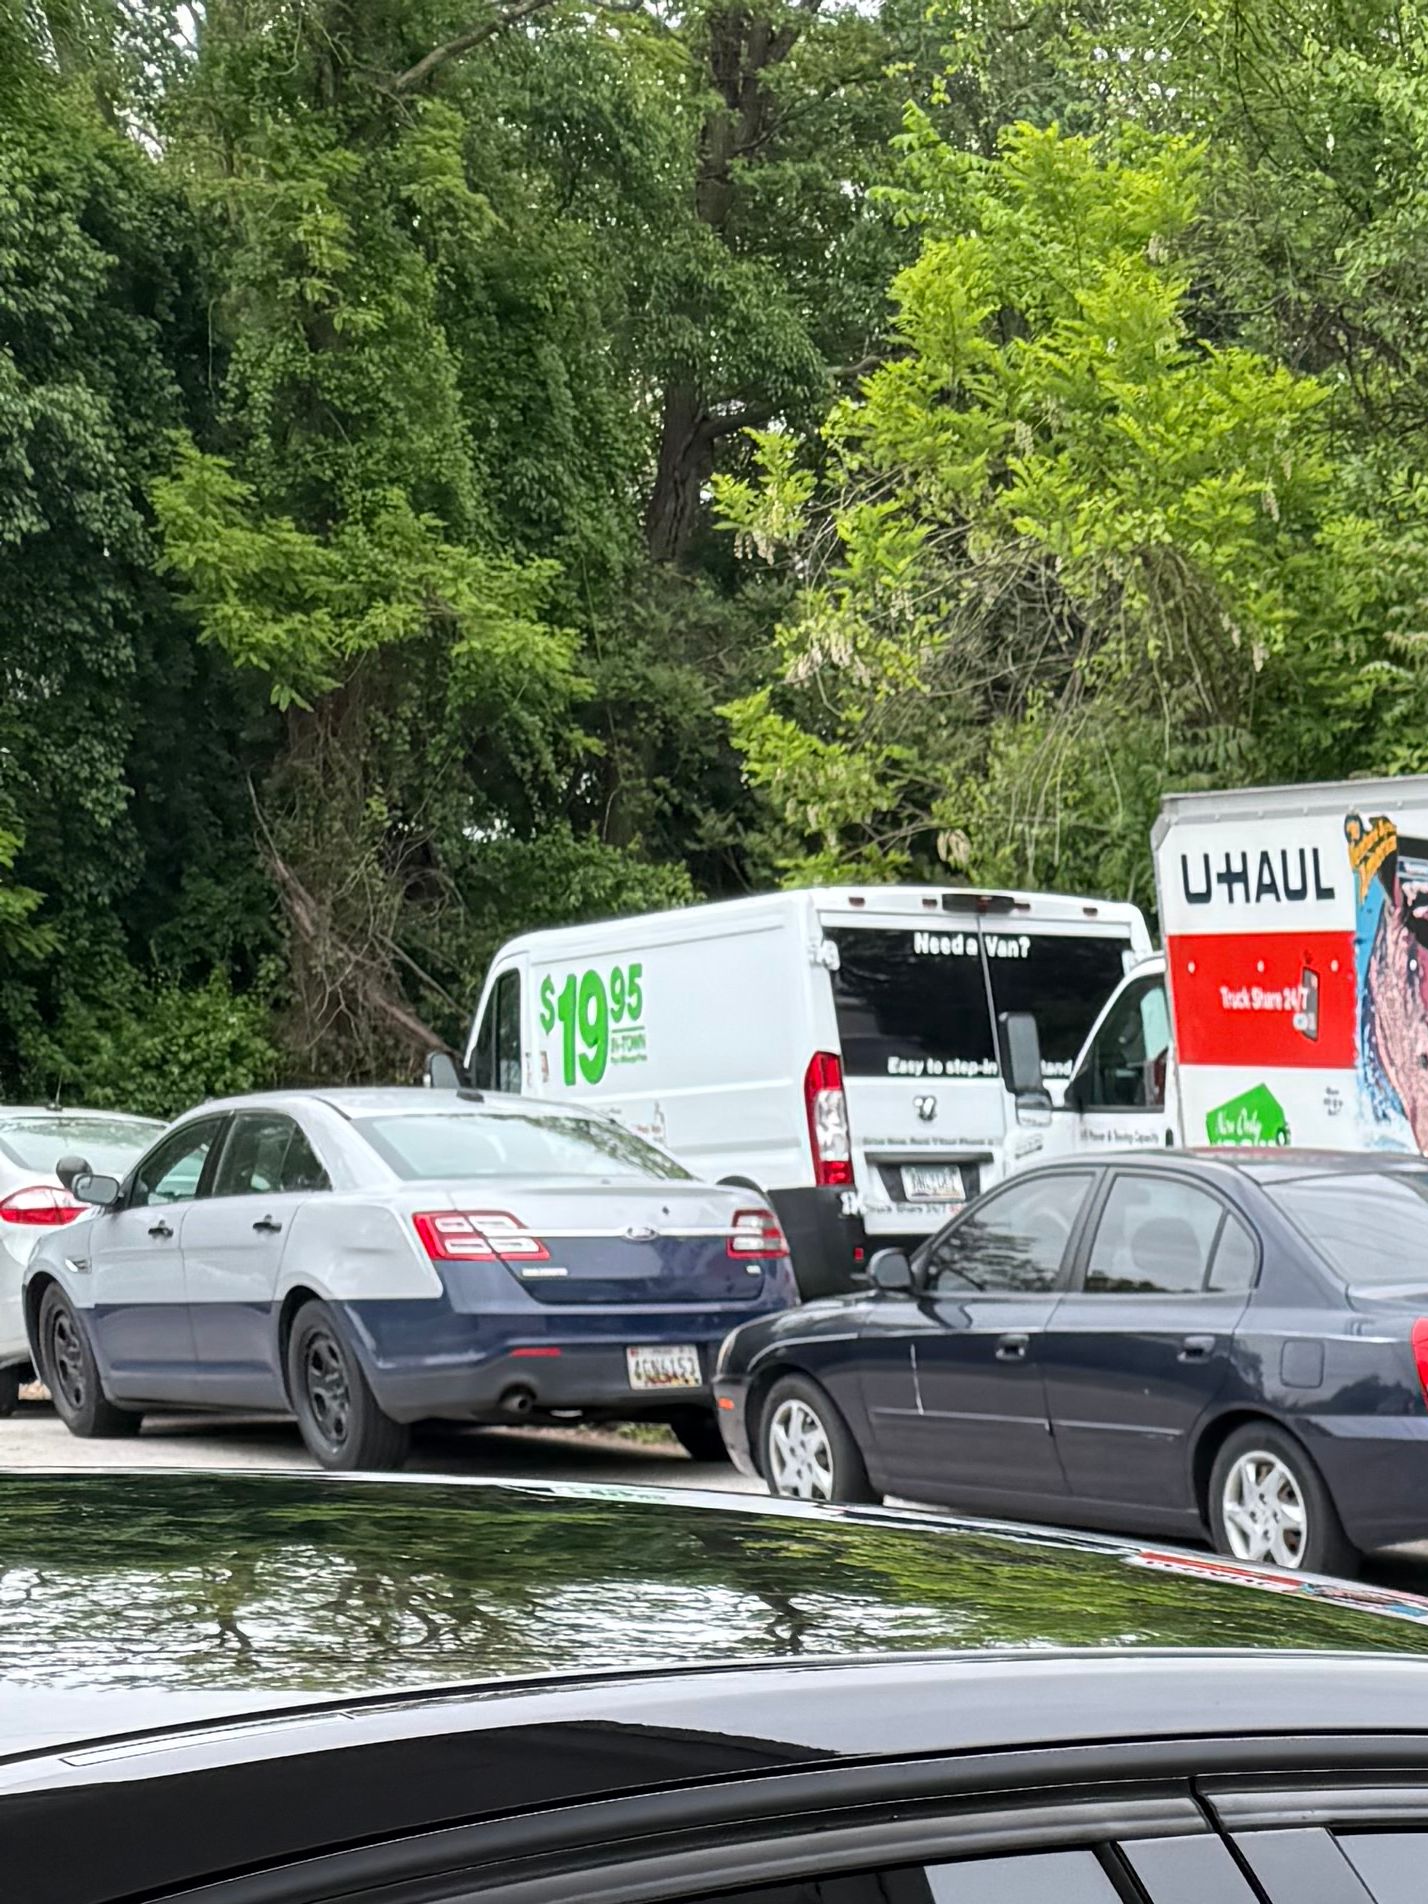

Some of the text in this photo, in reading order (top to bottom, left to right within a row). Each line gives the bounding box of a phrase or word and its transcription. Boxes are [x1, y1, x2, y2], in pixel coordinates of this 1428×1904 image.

[1181, 847, 1335, 904] U-HAUL
[914, 931, 1031, 958] Need a Van?
[1219, 985, 1251, 1010] Truck
[1251, 986, 1283, 1011] Share
[887, 1056, 925, 1077] Easy
[926, 1057, 943, 1074] to
